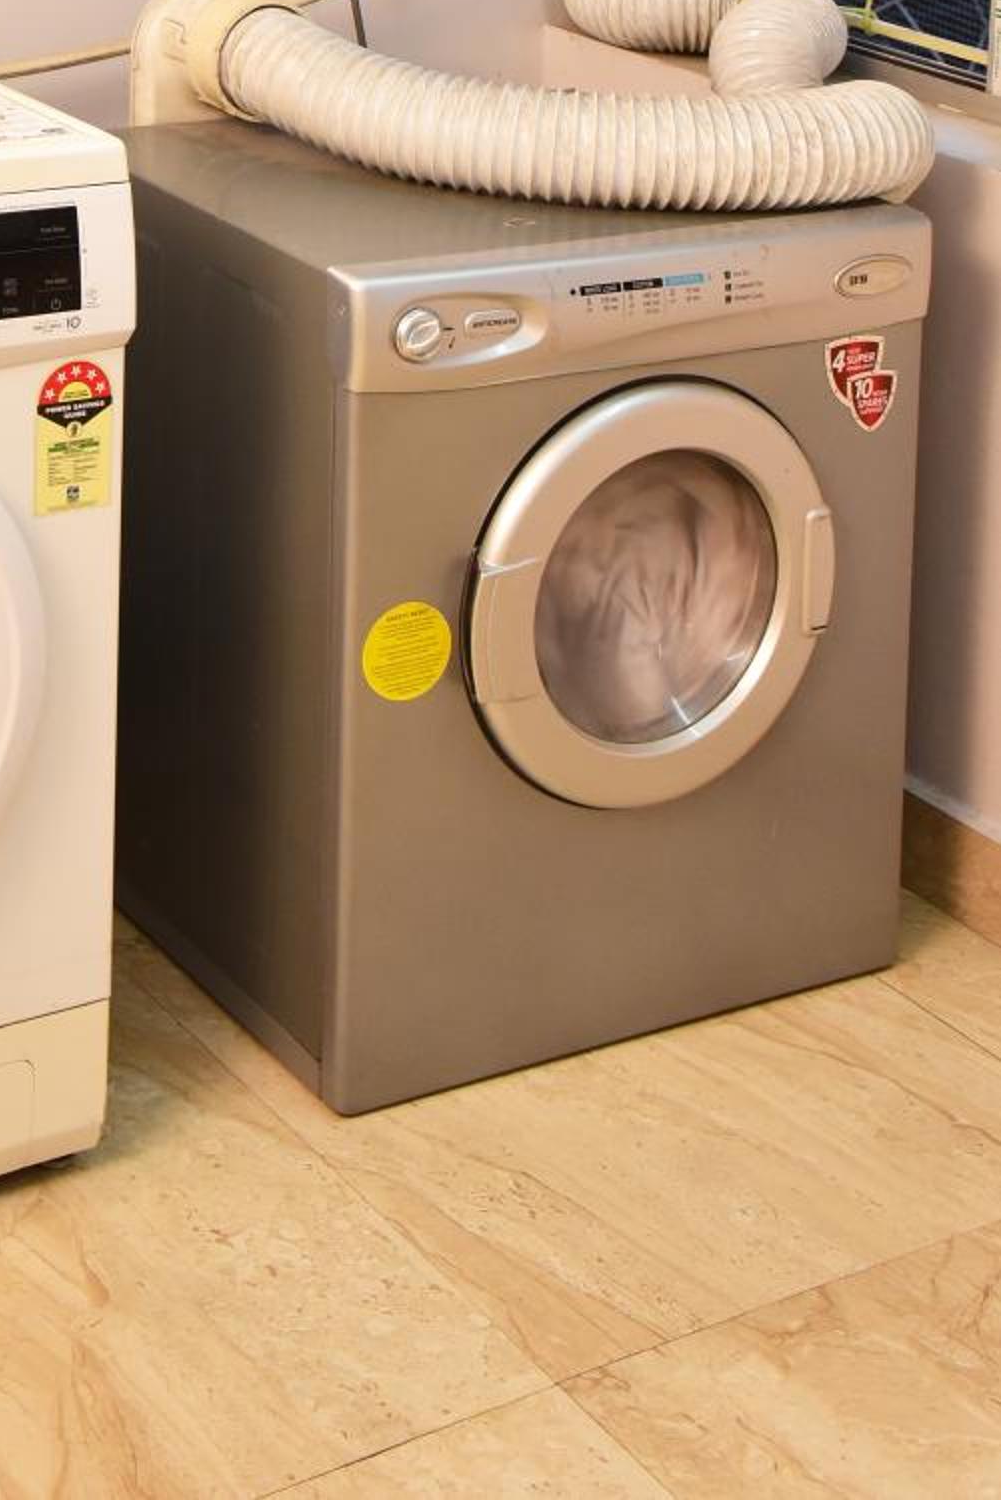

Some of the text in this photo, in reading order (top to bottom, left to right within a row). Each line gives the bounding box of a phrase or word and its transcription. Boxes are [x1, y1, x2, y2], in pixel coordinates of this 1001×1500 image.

[832, 349, 846, 373] 4
[846, 352, 876, 366] SUPER
[855, 377, 874, 399] 10
